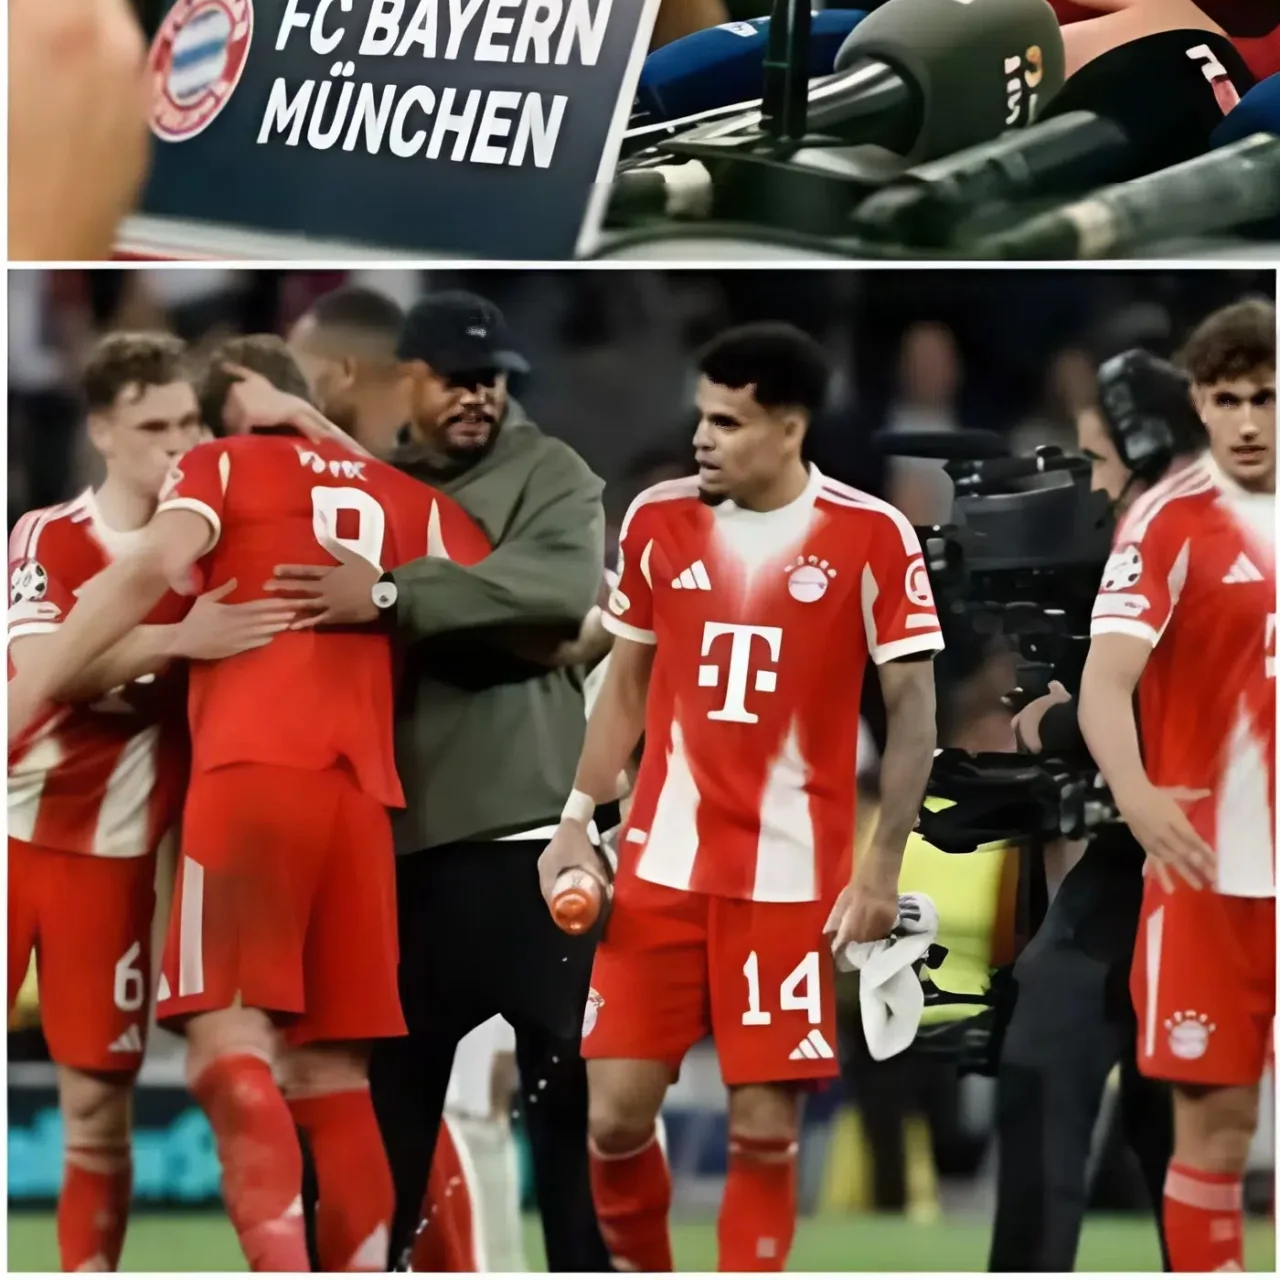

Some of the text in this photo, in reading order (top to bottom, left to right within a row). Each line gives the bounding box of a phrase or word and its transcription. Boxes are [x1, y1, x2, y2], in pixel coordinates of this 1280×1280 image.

[256, 60, 569, 170] MÜNCHEN
[113, 940, 145, 1012] 6
[741, 949, 822, 1026] 14
